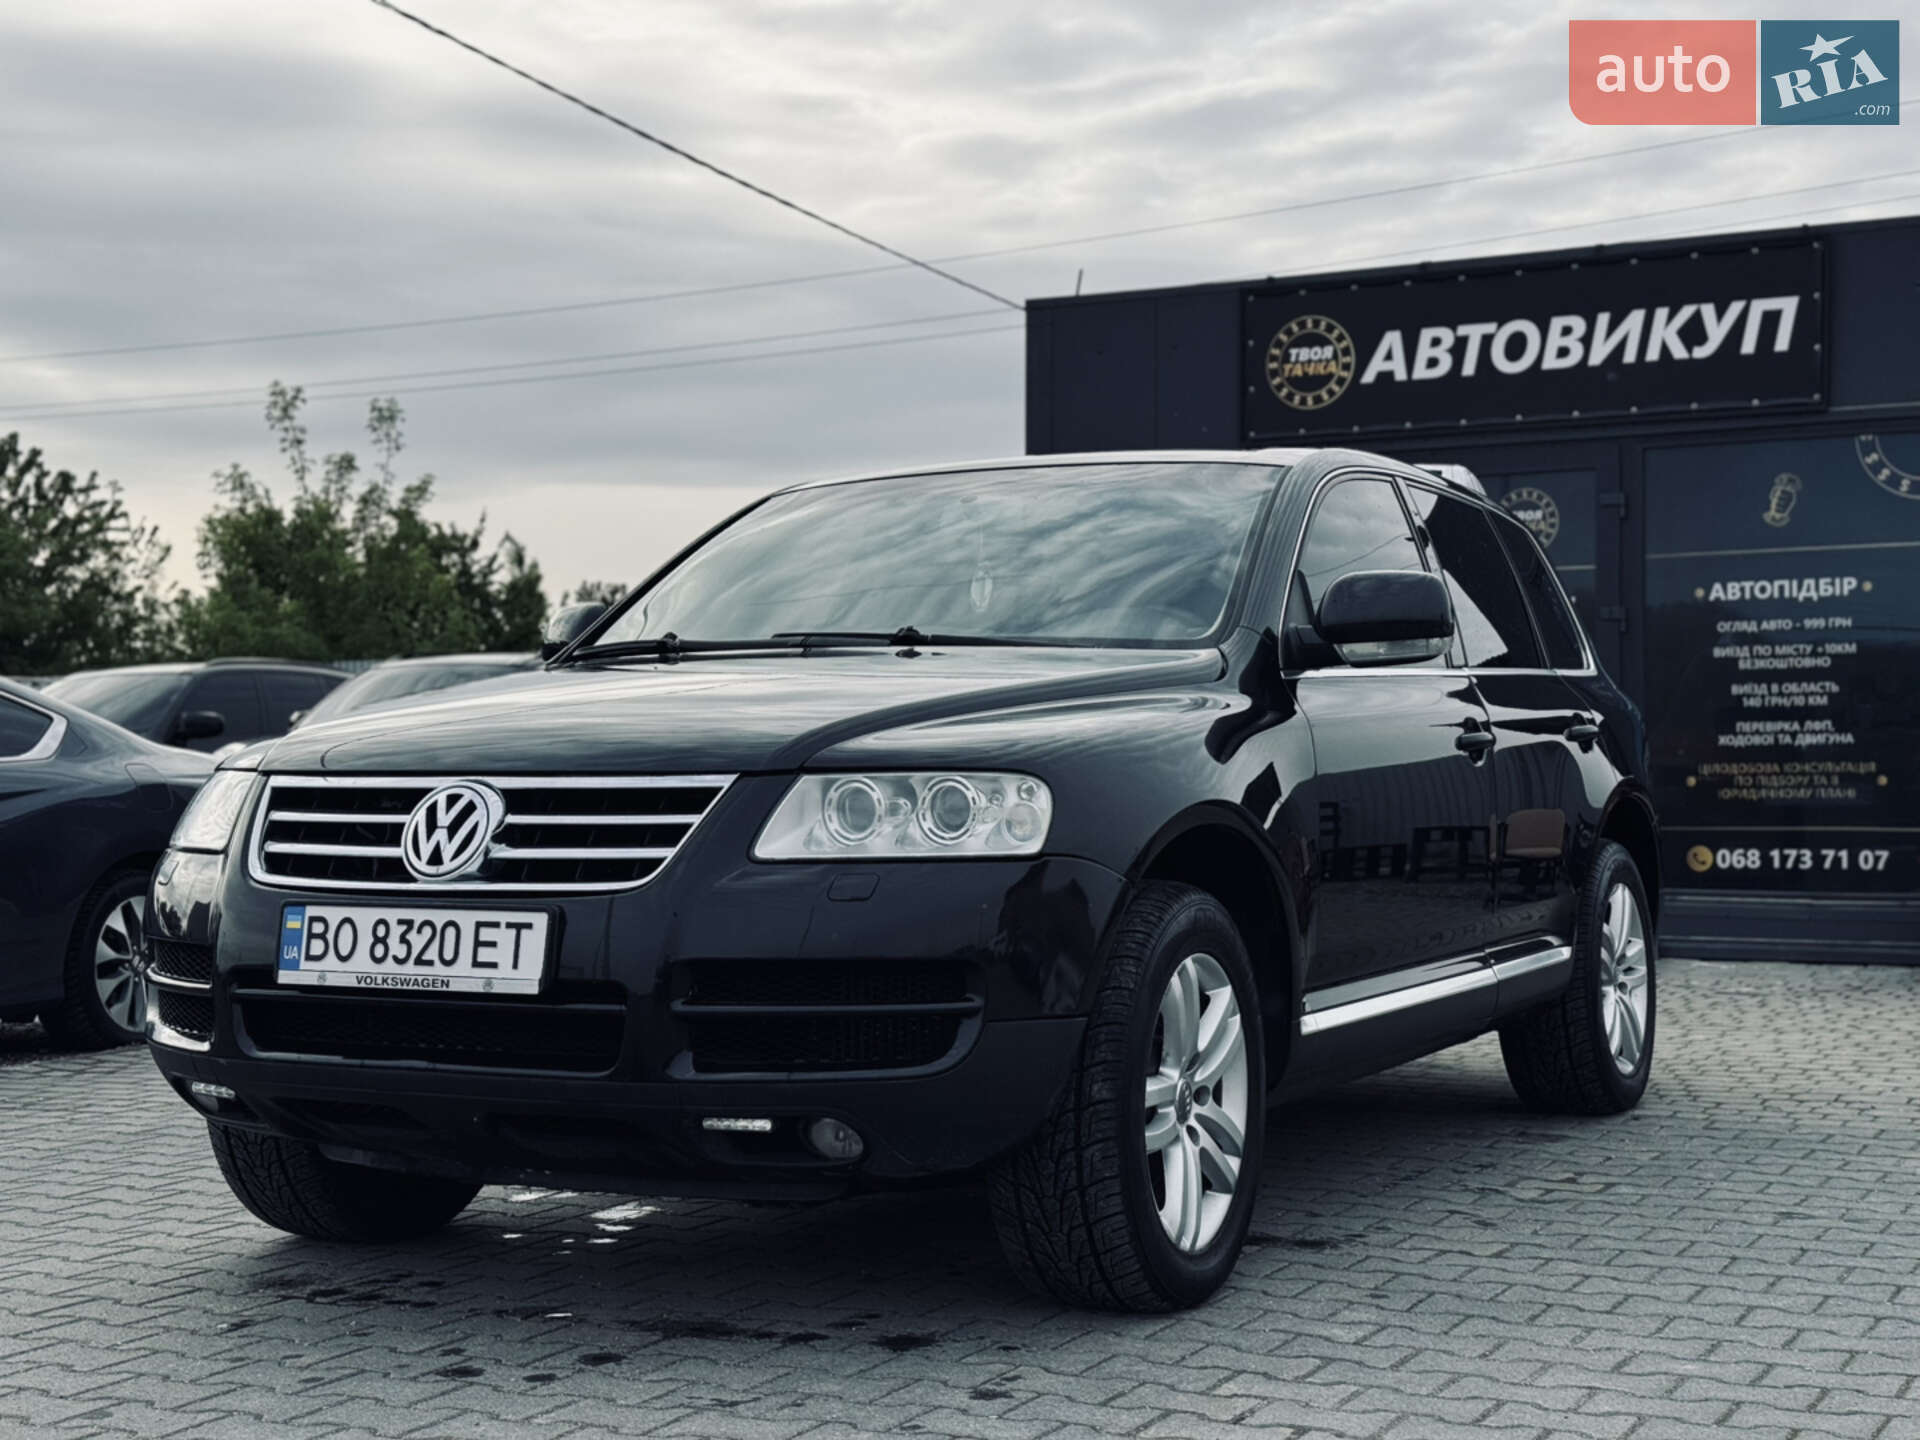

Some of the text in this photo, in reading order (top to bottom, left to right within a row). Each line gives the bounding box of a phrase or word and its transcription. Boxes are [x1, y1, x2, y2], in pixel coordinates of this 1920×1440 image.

[1360, 296, 1800, 384] АВТОВИКУП
[1288, 345, 1334, 363] ТВОЯ
[1283, 360, 1337, 377] ТАЧКА
[1709, 577, 1858, 602] АВТОПІДБІР
[1760, 619, 1793, 631] АВТО
[1828, 616, 1853, 629] ГРН
[1752, 645, 1772, 656] ПО
[1781, 681, 1840, 694] ОБЛАСТЬ
[1777, 734, 1793, 745] ТА
[1794, 732, 1854, 748] ДВИГУНА
[1715, 848, 1890, 871] 068 173 71 07
[304, 915, 533, 970] BO 8320 ET
[283, 945, 299, 960] UA
[355, 975, 450, 989] VOLKSWAGEN
